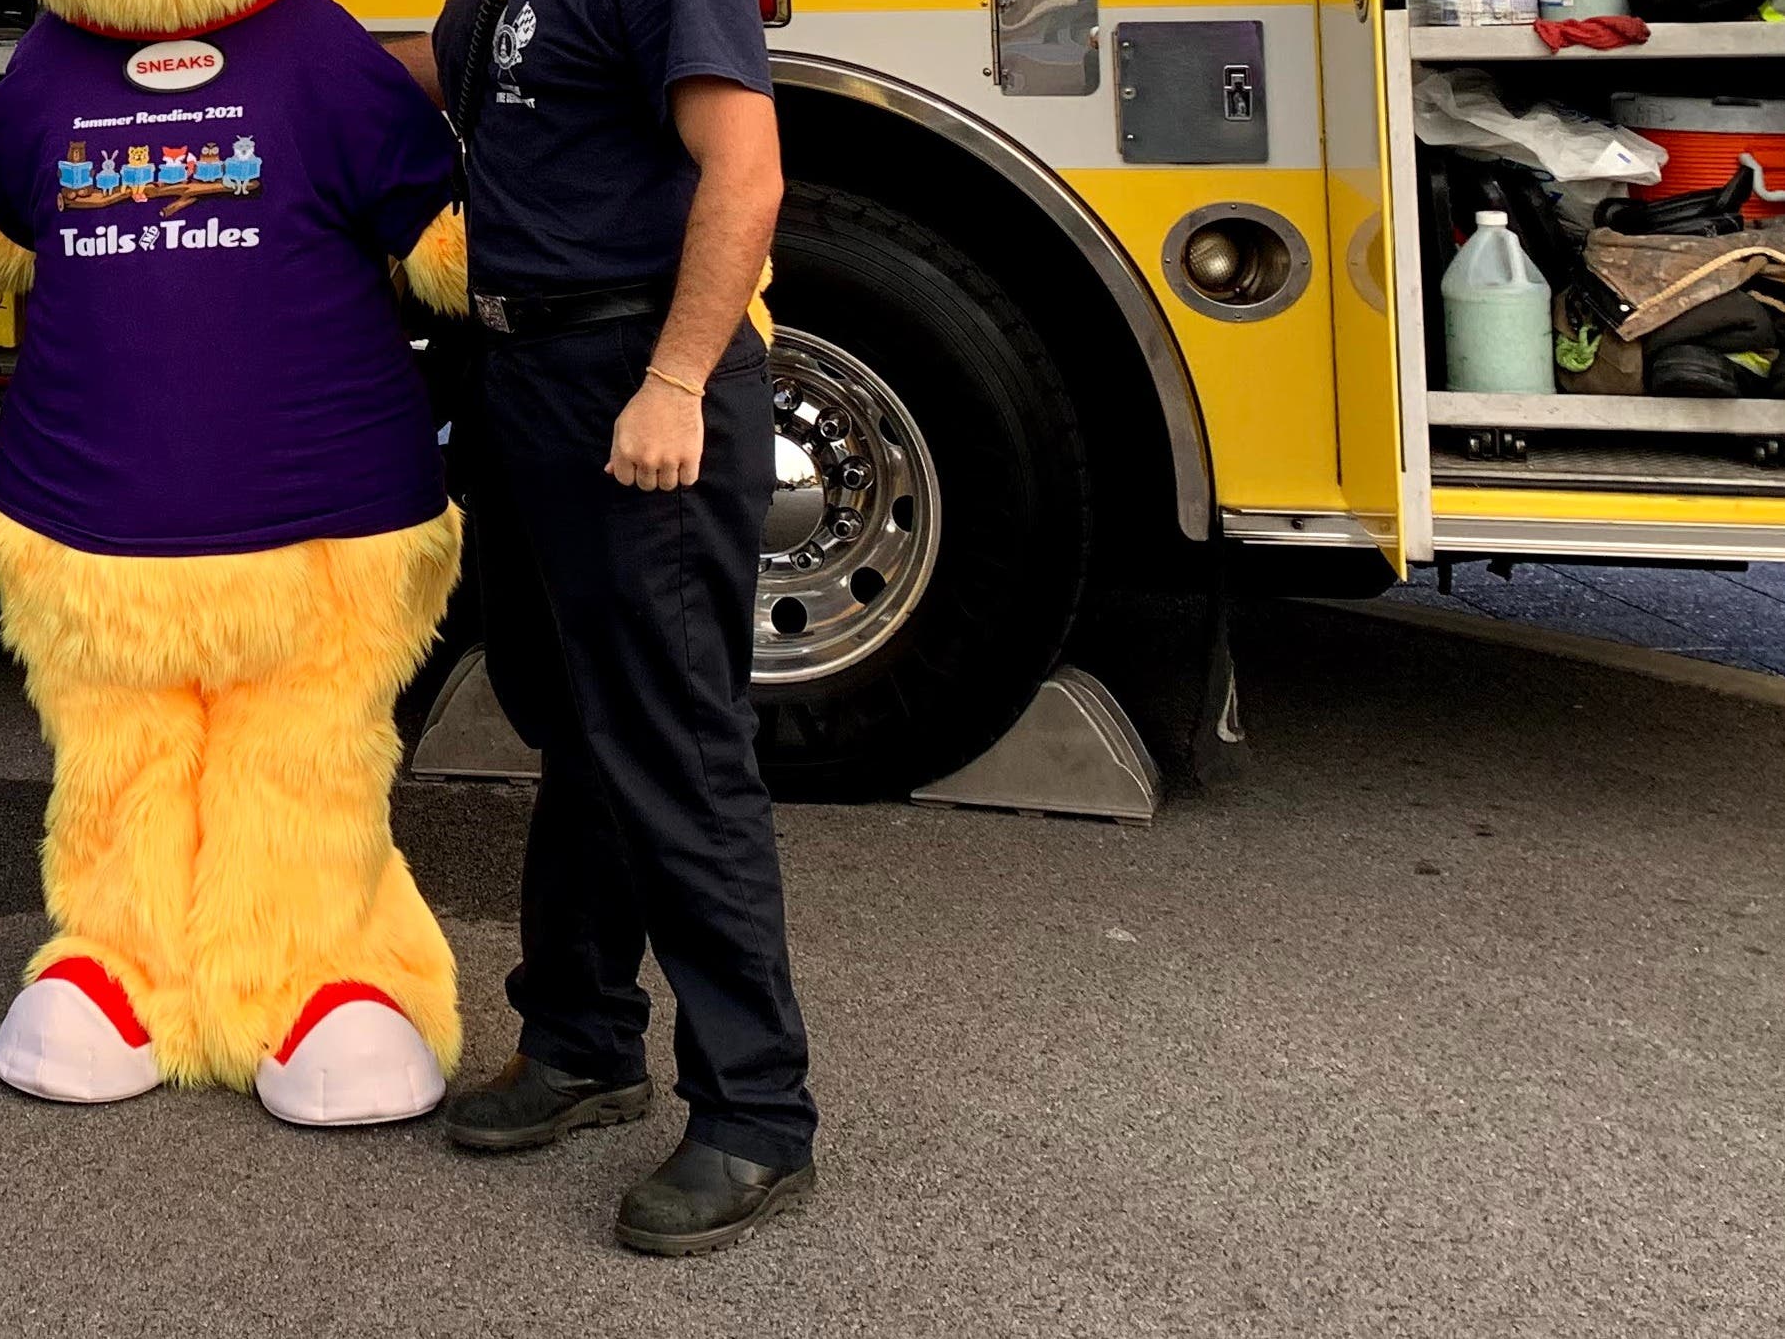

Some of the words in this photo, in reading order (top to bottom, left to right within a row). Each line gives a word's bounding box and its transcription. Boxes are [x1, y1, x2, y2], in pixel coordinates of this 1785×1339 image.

[136, 54, 216, 75] SNEAKS
[72, 116, 134, 130] Summer
[135, 108, 204, 125] Reading
[204, 105, 244, 120] 2021
[59, 224, 137, 257] Tails
[139, 225, 161, 251] AND
[159, 217, 260, 249] Tales
